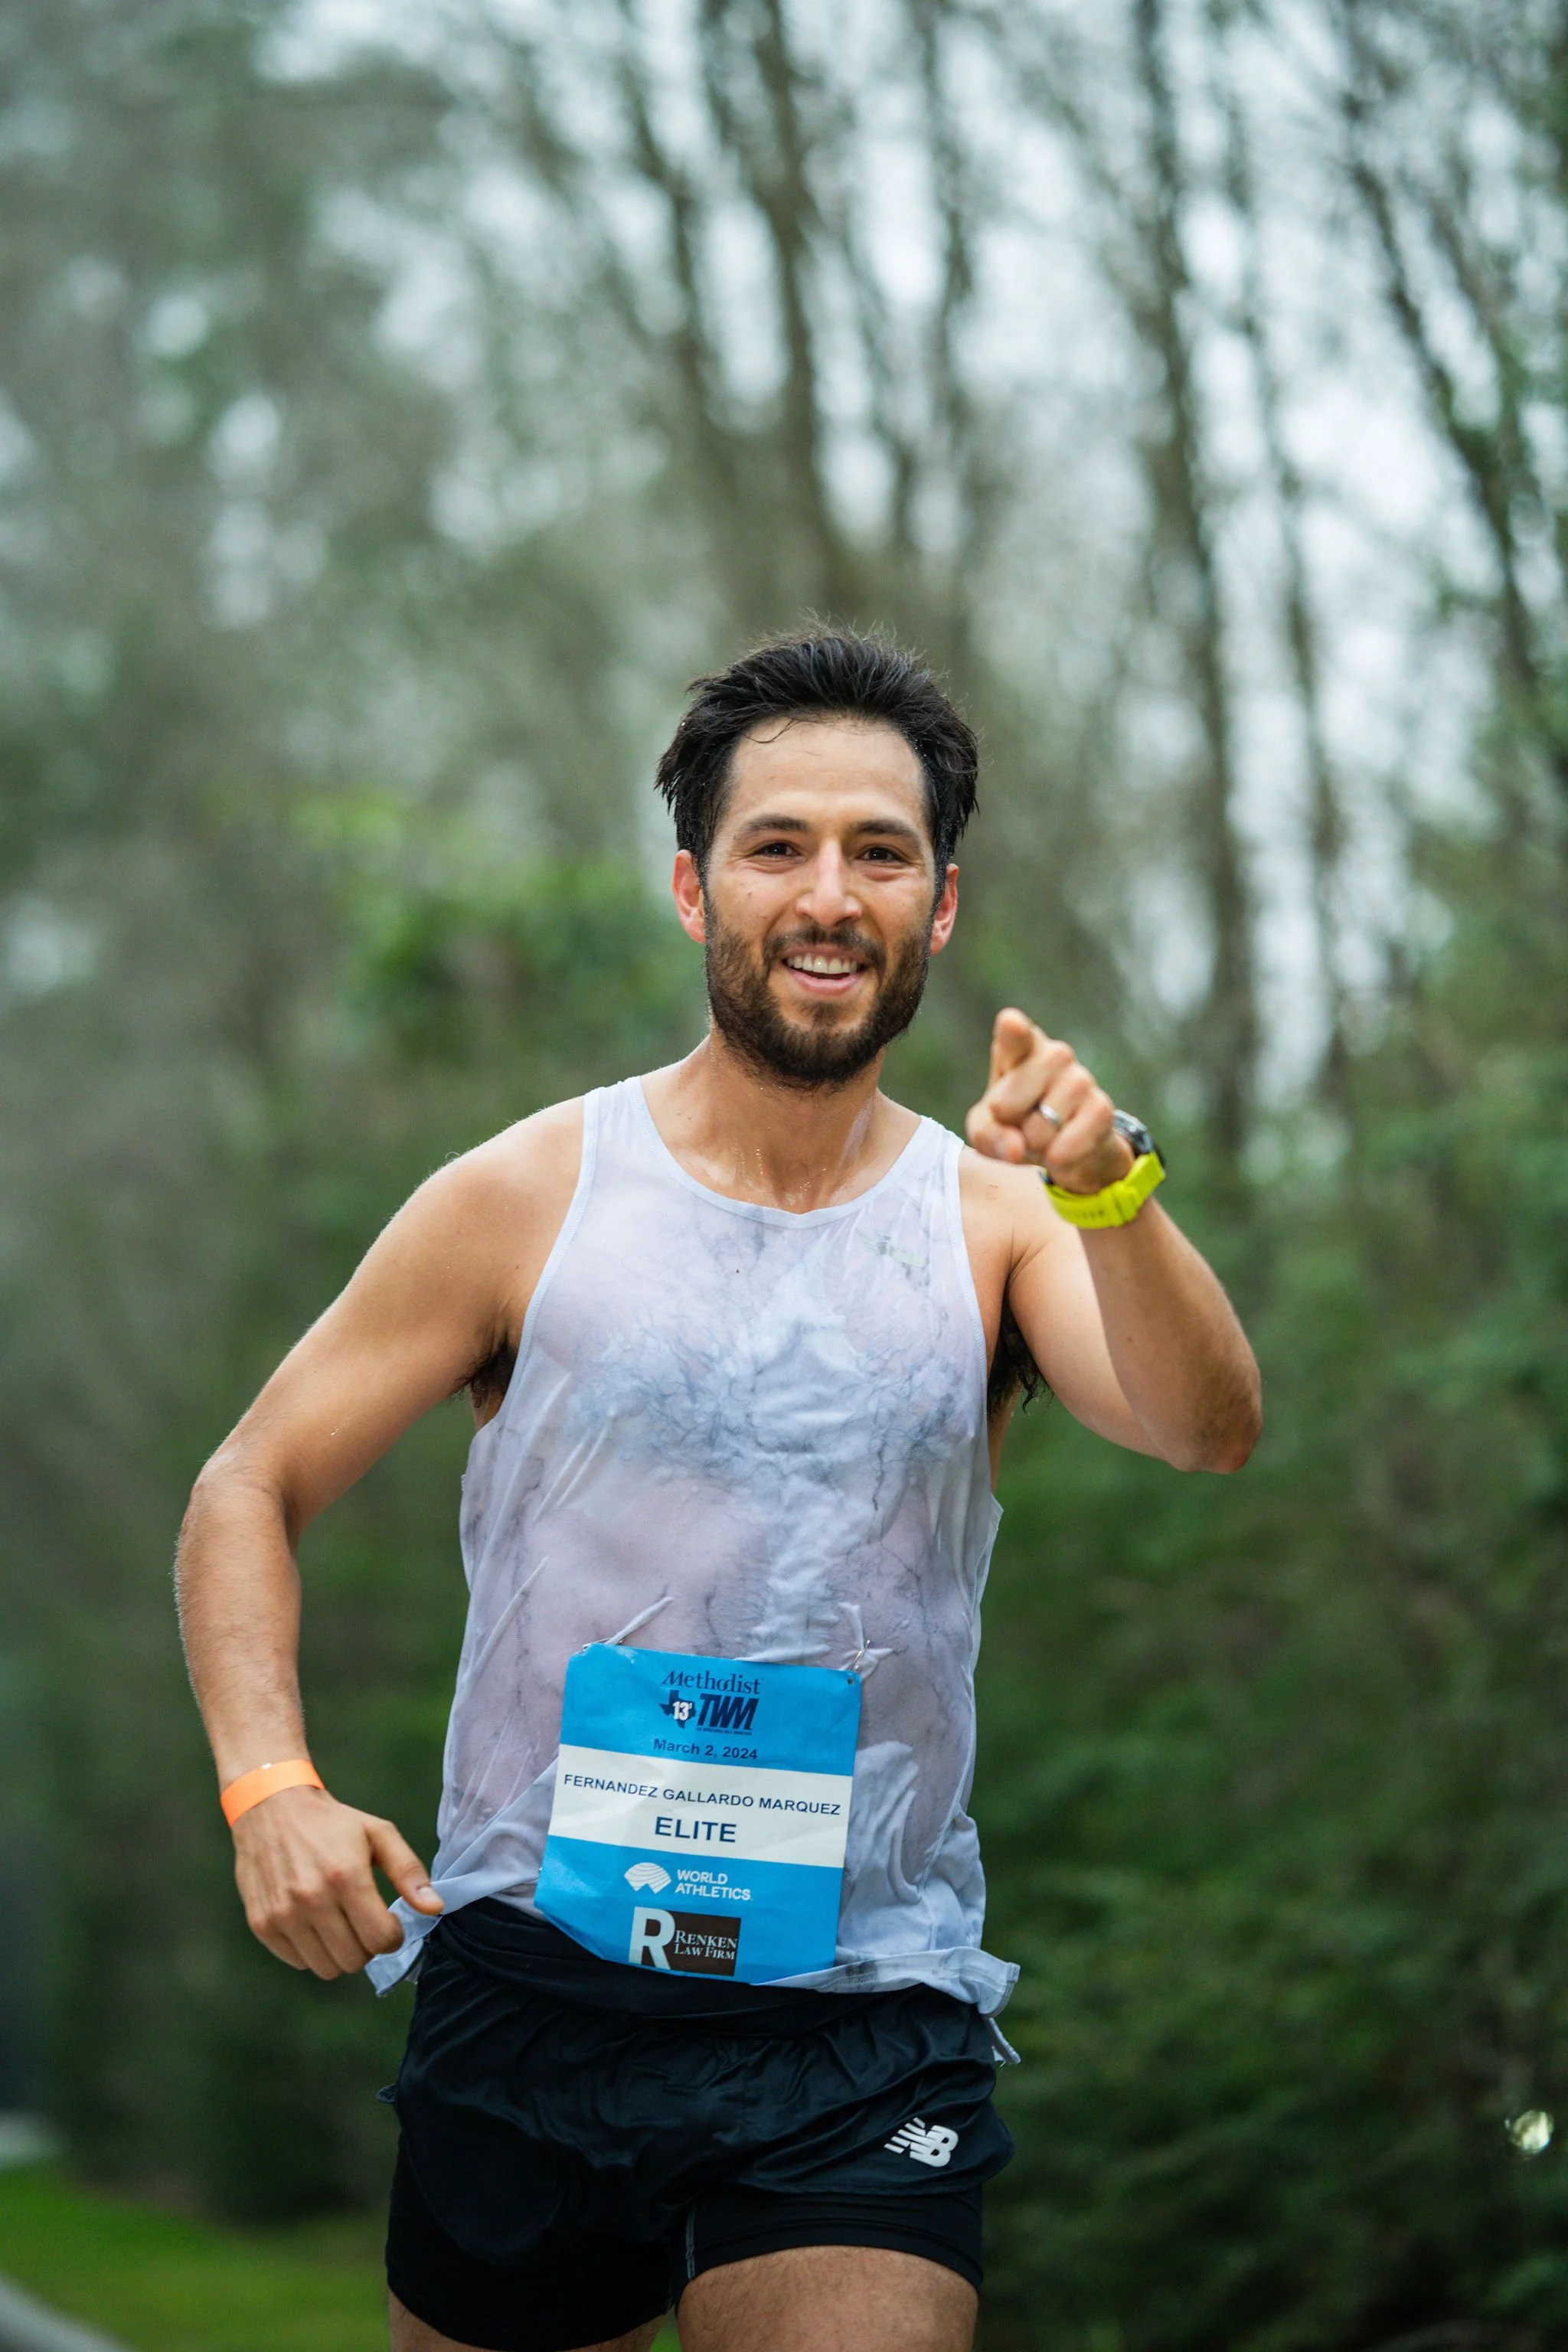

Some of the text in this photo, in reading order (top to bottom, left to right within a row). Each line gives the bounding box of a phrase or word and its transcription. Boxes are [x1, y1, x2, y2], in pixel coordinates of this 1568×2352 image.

[662, 1670, 761, 1695] Methodist
[697, 1693, 760, 1730] TWM
[653, 1738, 758, 1760] March 2, 2024
[564, 1774, 841, 1816] FERNANDEZ GALLARDO MARQUEZ
[655, 1816, 737, 1843] ELITE
[677, 1869, 728, 1885] WORLD
[675, 1883, 751, 1901] ATHLETICS
[629, 1906, 675, 1970] R
[675, 1929, 737, 1949] RENKEN
[675, 1943, 735, 1960] LAW FIRM
